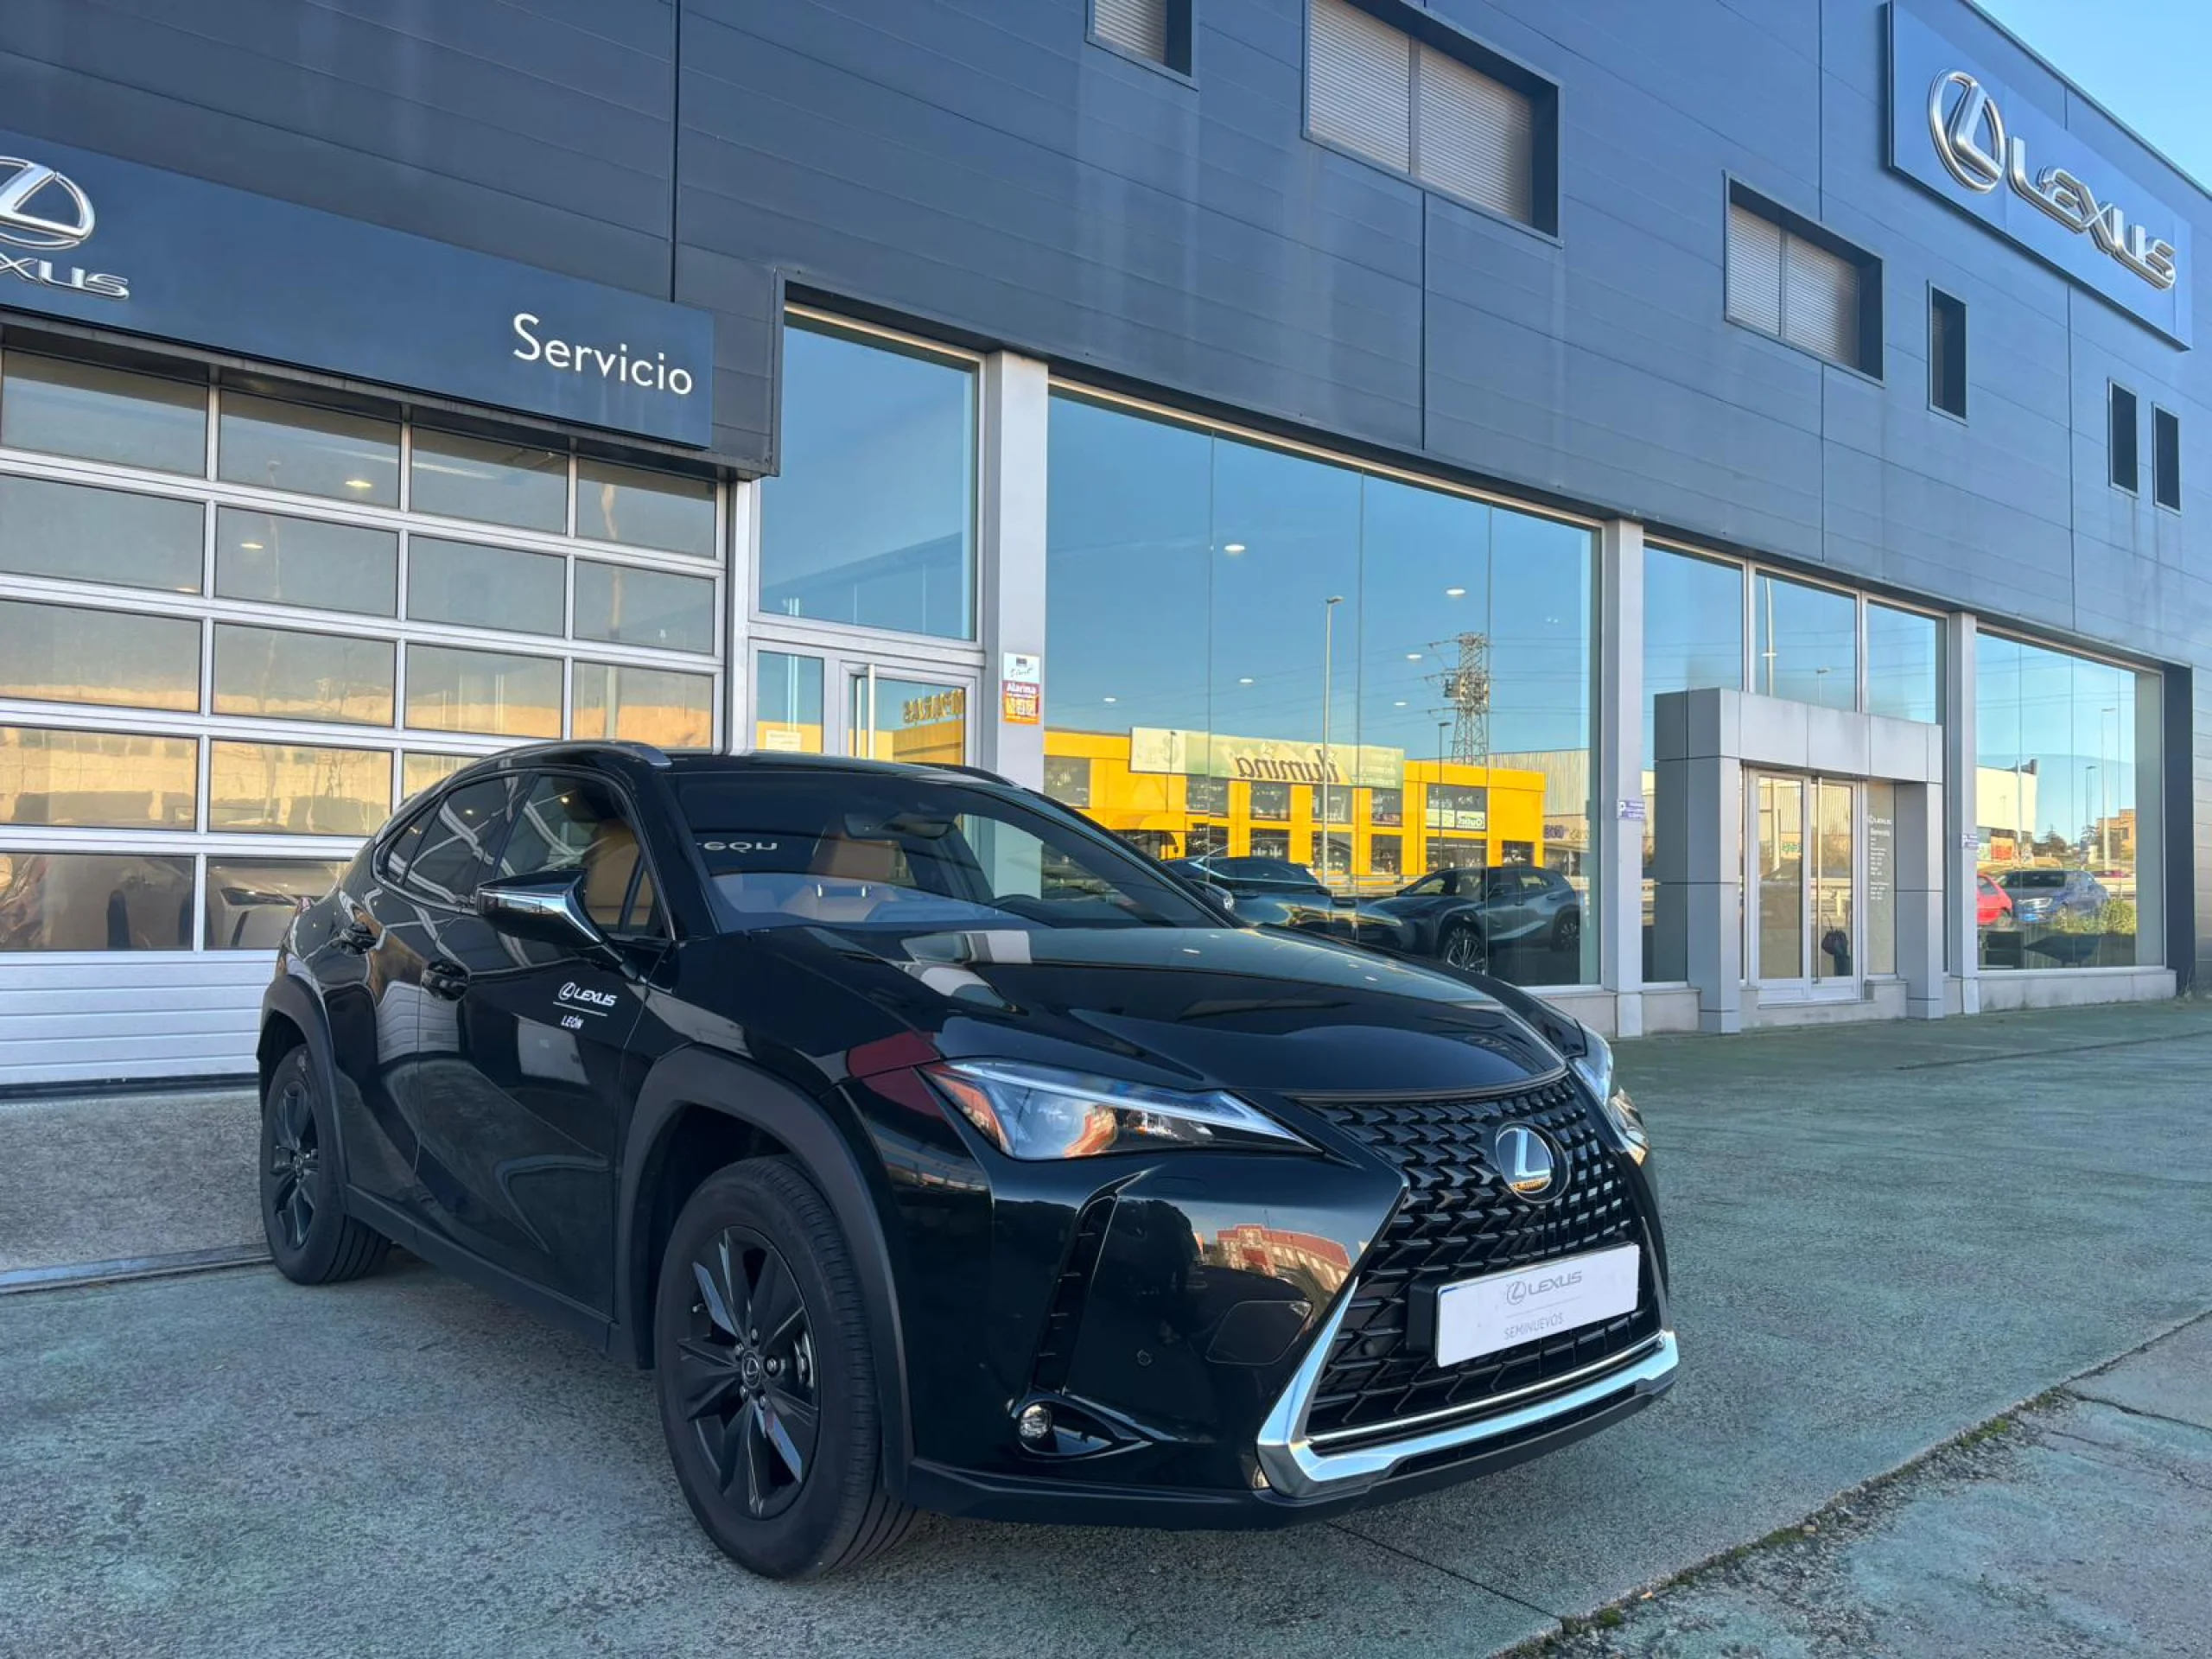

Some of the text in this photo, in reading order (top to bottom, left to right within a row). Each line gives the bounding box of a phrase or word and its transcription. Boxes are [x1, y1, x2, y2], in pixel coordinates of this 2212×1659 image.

[2007, 136, 2176, 289] LEXUS
[0, 252, 129, 299] XUS
[513, 312, 693, 395] Servicio
[574, 987, 618, 1007] LEXUS
[1529, 1269, 1582, 1295] LEXUS
[1503, 1312, 1564, 1339] SEMINUEVOS
